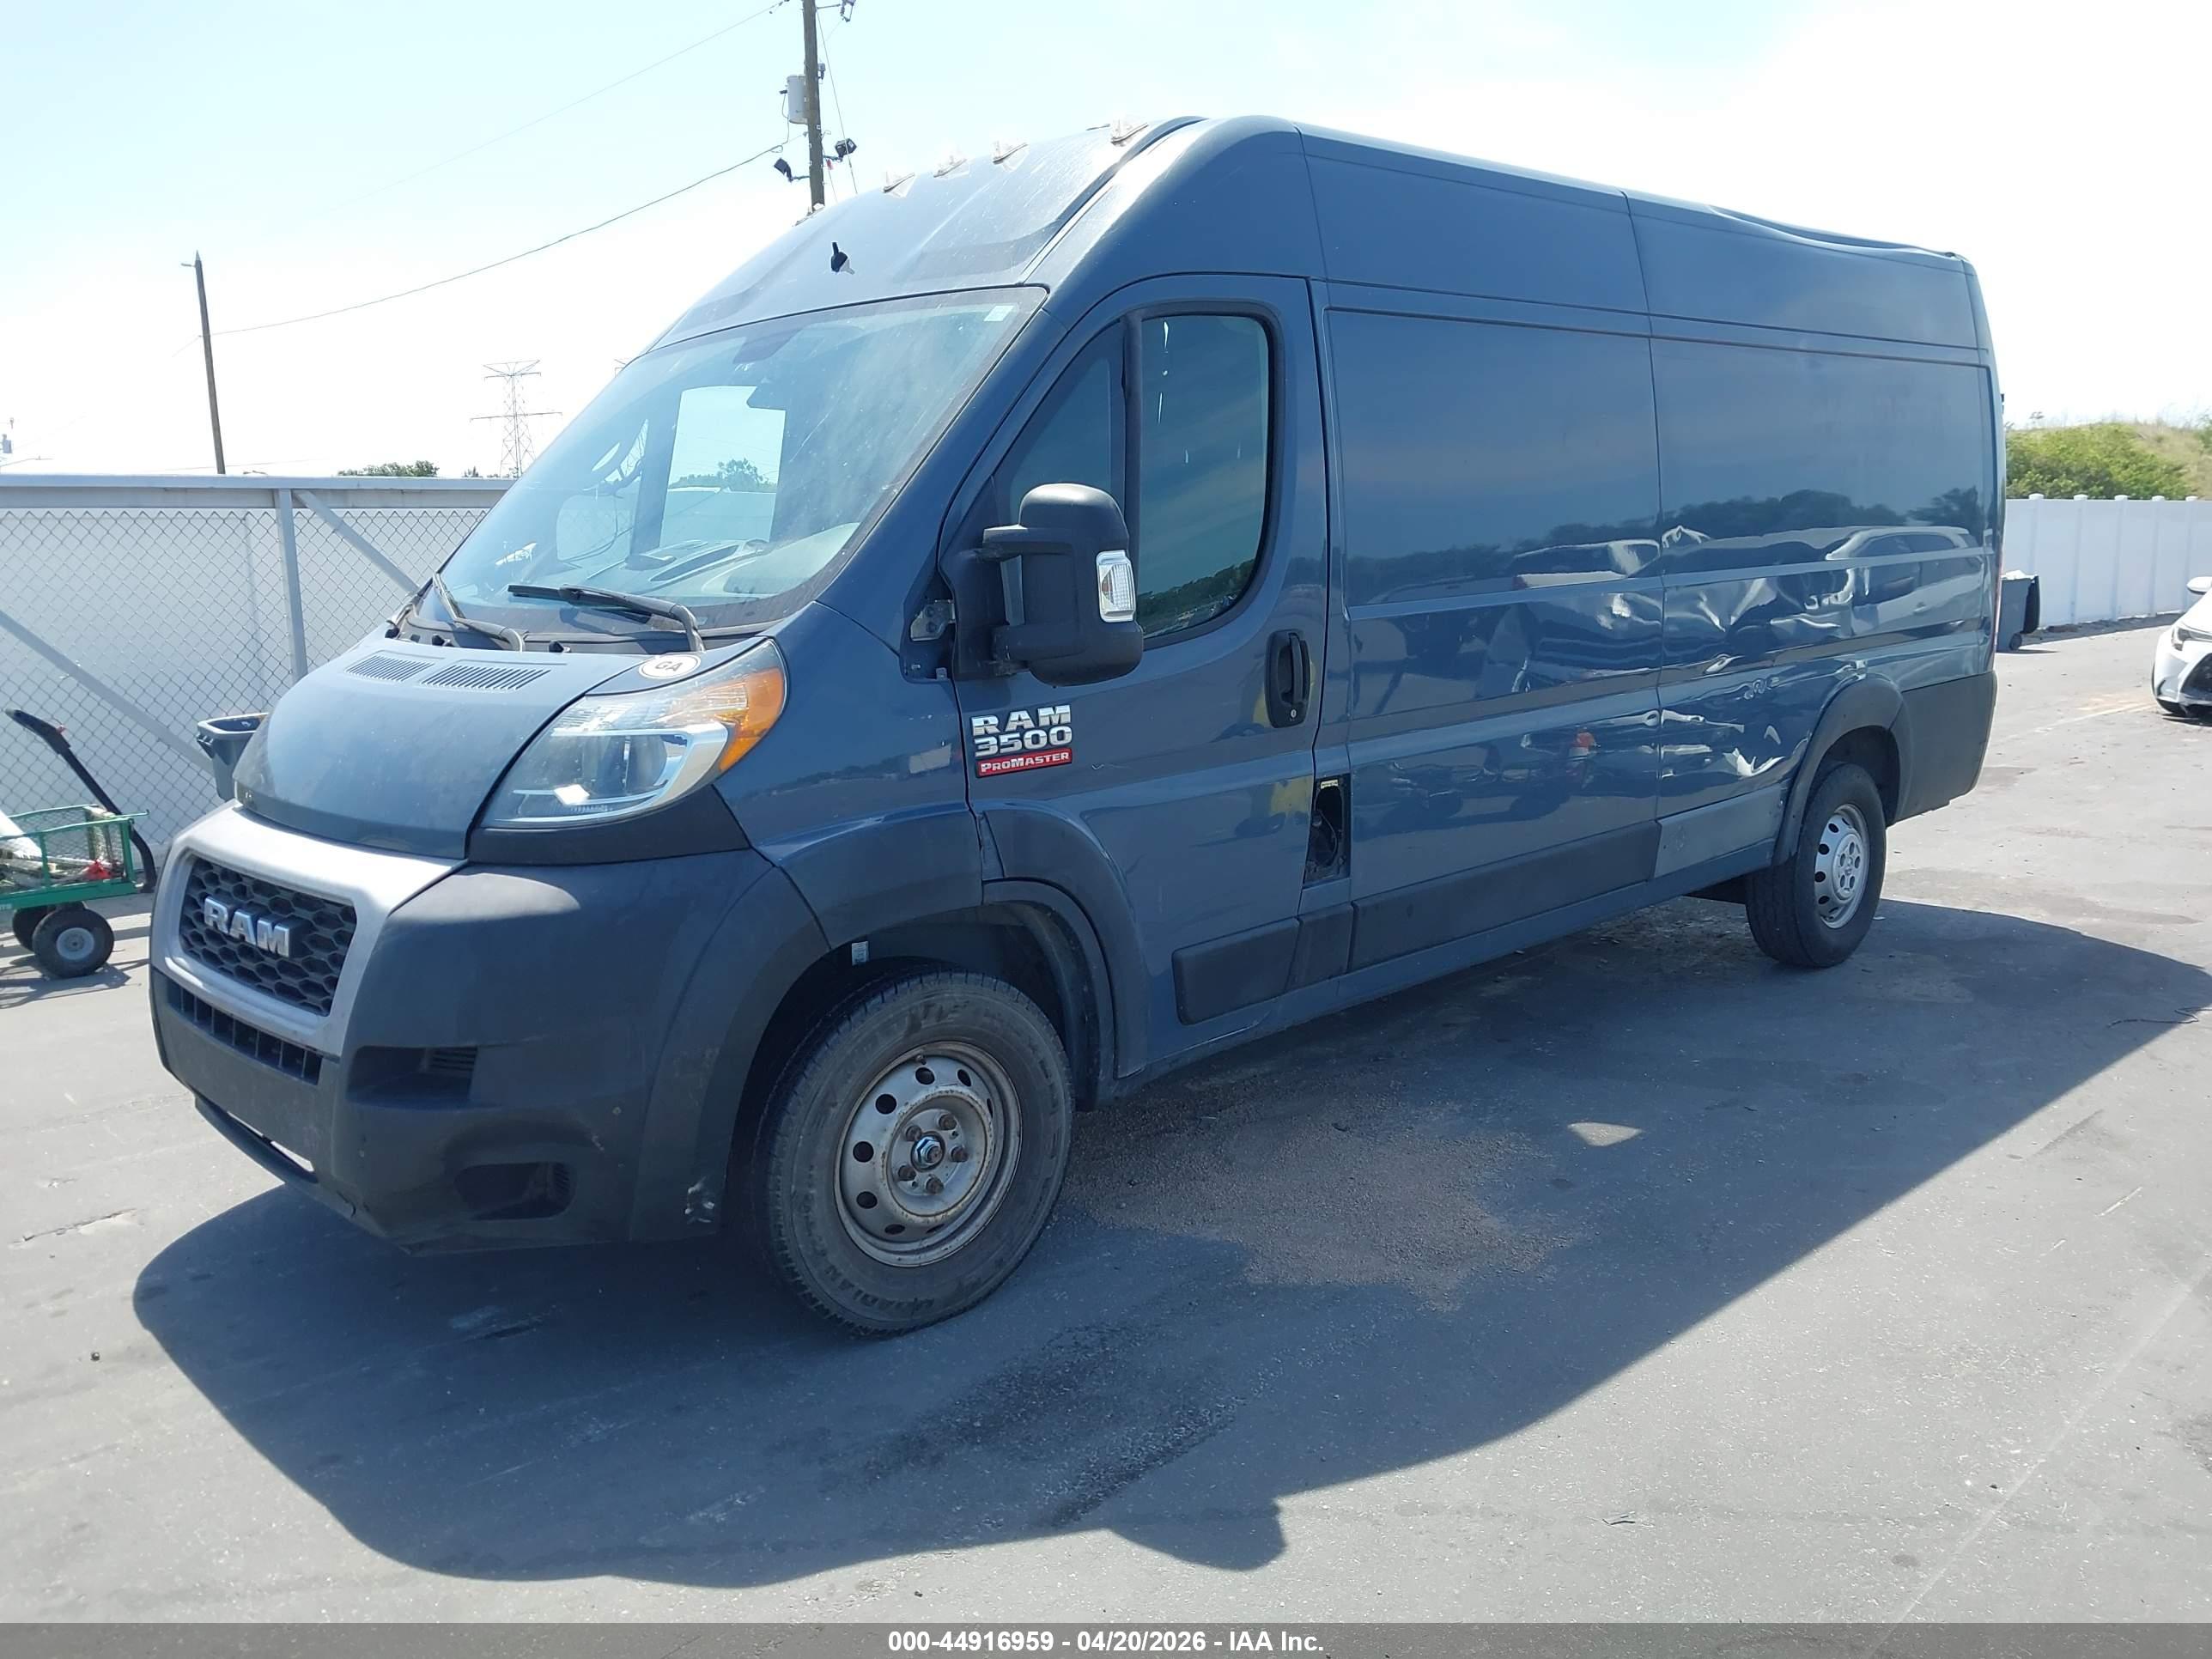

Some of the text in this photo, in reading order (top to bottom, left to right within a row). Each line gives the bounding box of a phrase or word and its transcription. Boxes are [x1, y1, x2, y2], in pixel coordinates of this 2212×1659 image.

[655, 660, 684, 672] GA
[971, 704, 1072, 736] RAM
[975, 726, 1073, 757] 3500
[204, 896, 290, 958] RAM
